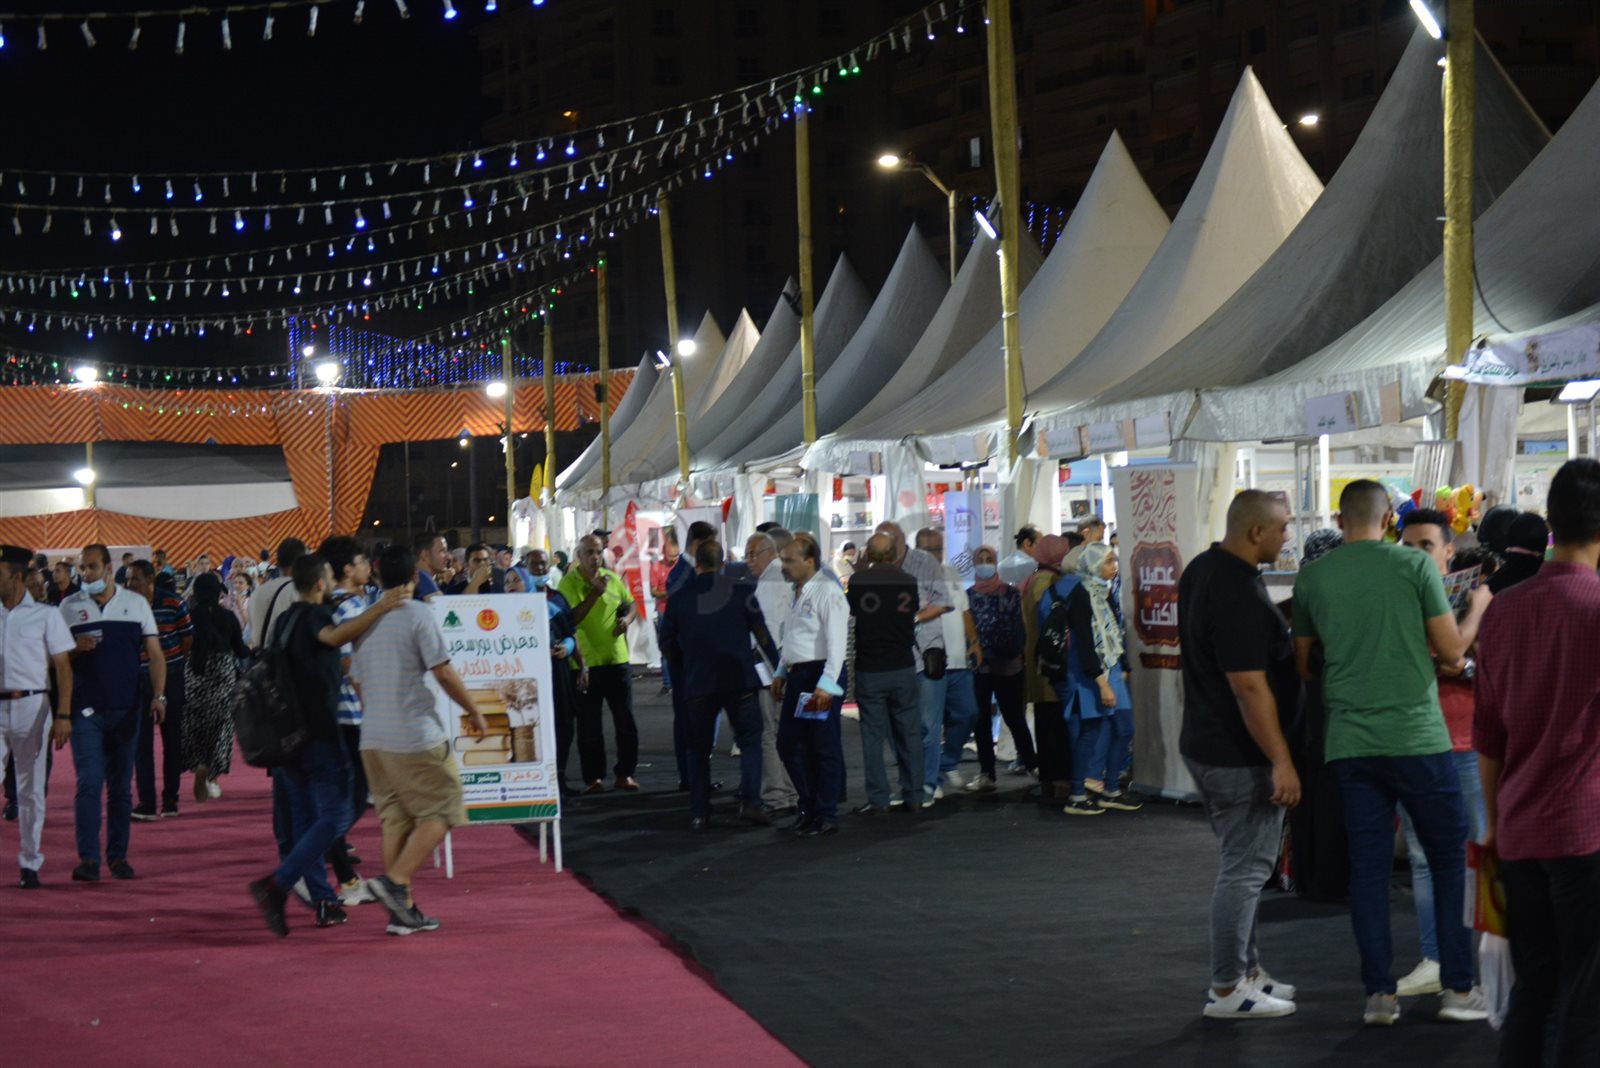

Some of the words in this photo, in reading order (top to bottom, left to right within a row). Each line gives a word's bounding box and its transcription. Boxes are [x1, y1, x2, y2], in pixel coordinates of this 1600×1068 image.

[1139, 565, 1176, 591] عصير
[78, 609, 89, 621] 3
[1140, 602, 1179, 630] الكتب
[494, 634, 538, 656] معرض
[495, 658, 525, 677] الرابع
